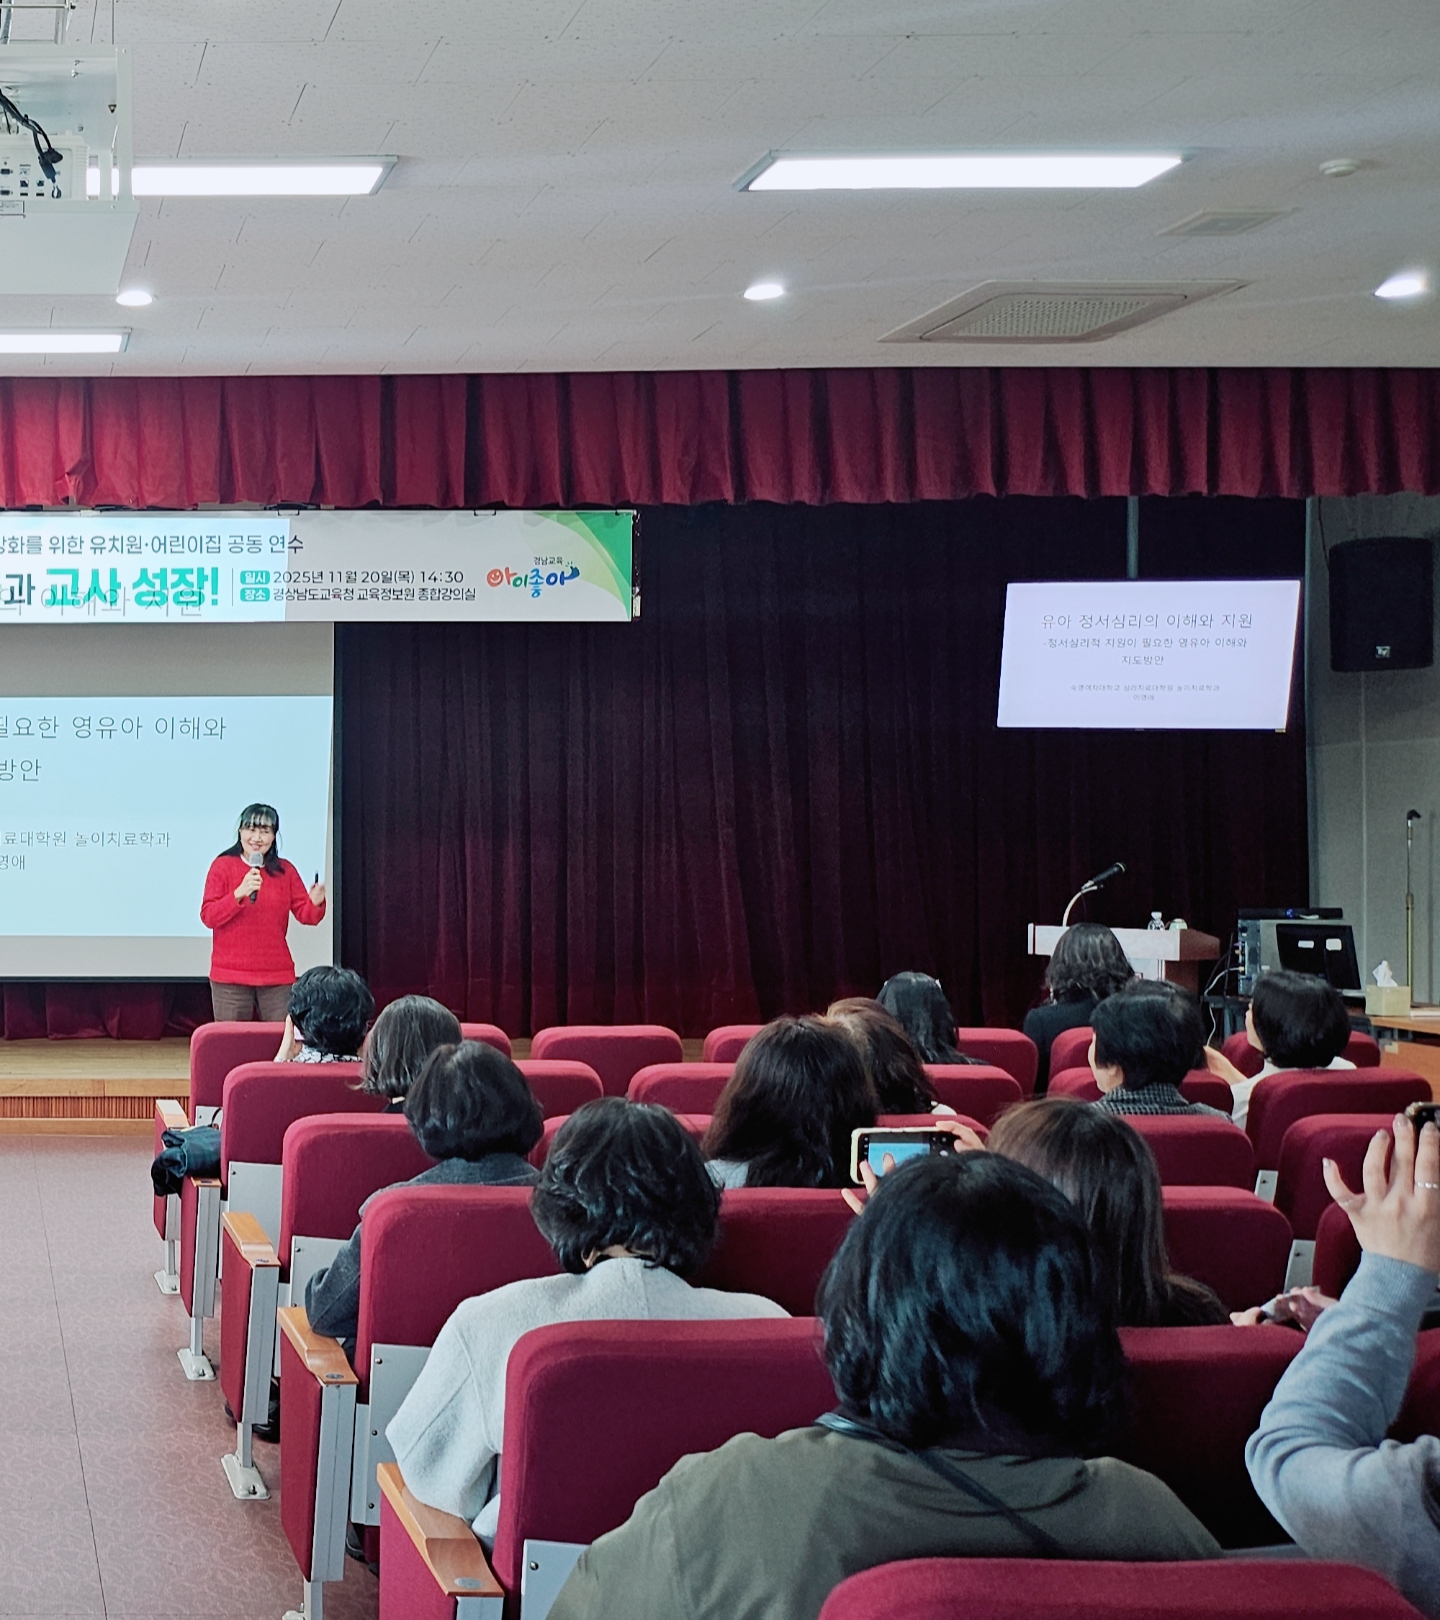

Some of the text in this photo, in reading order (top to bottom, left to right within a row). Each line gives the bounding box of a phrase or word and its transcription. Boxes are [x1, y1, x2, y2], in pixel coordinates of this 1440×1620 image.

[49, 535, 84, 554] 위한
[90, 535, 221, 555] 유치원·어린이집
[228, 535, 262, 554] 공동
[269, 535, 304, 554] 연수
[533, 556, 563, 566] 경남교육
[244, 571, 266, 584] 일시
[273, 571, 323, 583] 2025년
[329, 571, 357, 583] 11월
[420, 571, 463, 583] 14:30
[486, 566, 580, 598] 아이좋아
[45, 568, 121, 606] 교사
[132, 567, 218, 606] 성장!
[244, 588, 475, 601] 장소 경상남도교육청 교육정보원 종합강의실
[1041, 613, 1253, 630] 유아 정서심리의 이해와 지원
[1105, 637, 1137, 649] 지원이
[1142, 637, 1174, 648] 필요한
[1178, 637, 1210, 648] 영유아
[1214, 637, 1247, 649] 이해와
[1121, 655, 1164, 666] 지도방안
[72, 715, 144, 740] 영유아
[154, 716, 227, 741] 이해와
[75, 831, 171, 848] 놀이치료학과
